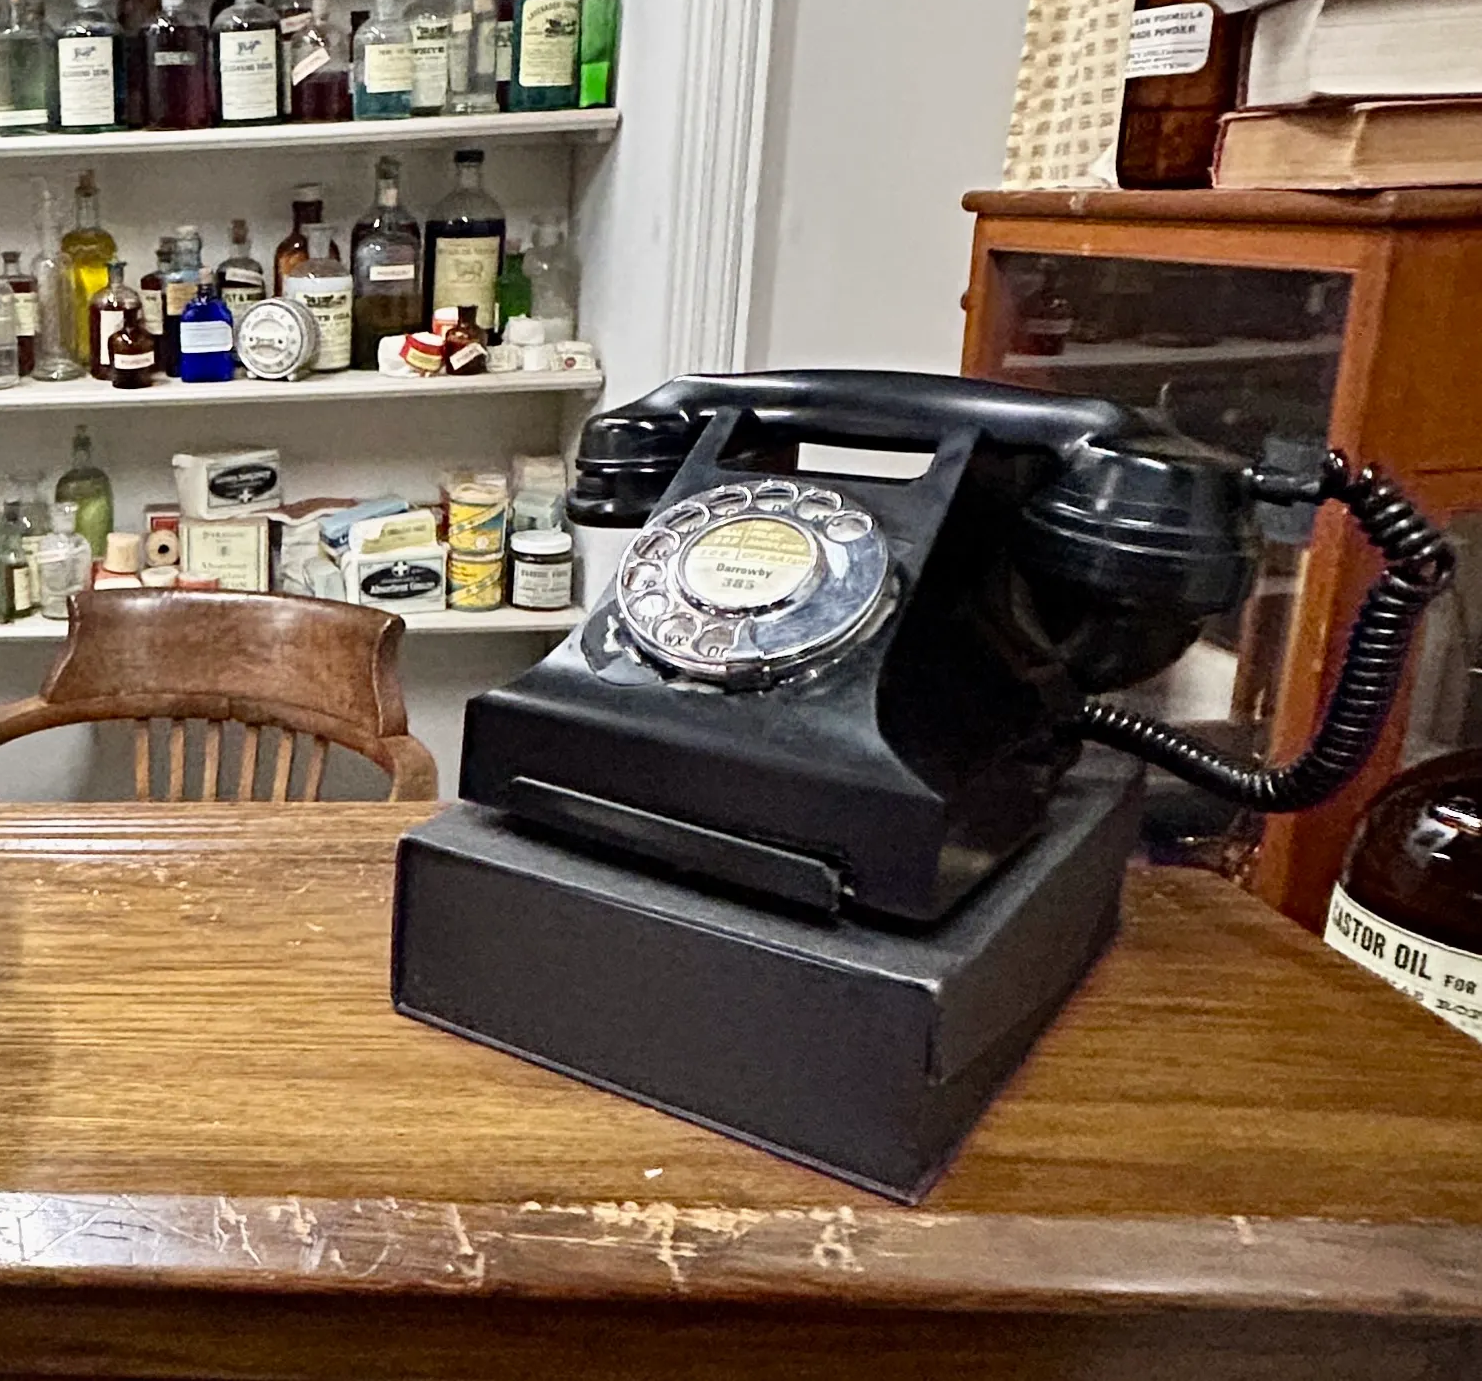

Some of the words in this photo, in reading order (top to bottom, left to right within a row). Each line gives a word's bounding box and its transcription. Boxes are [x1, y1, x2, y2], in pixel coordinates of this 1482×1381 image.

[715, 561, 774, 580] Darrowby
[721, 576, 756, 591] 385
[1394, 943, 1432, 981] OIL
[1444, 974, 1478, 995] FOR
